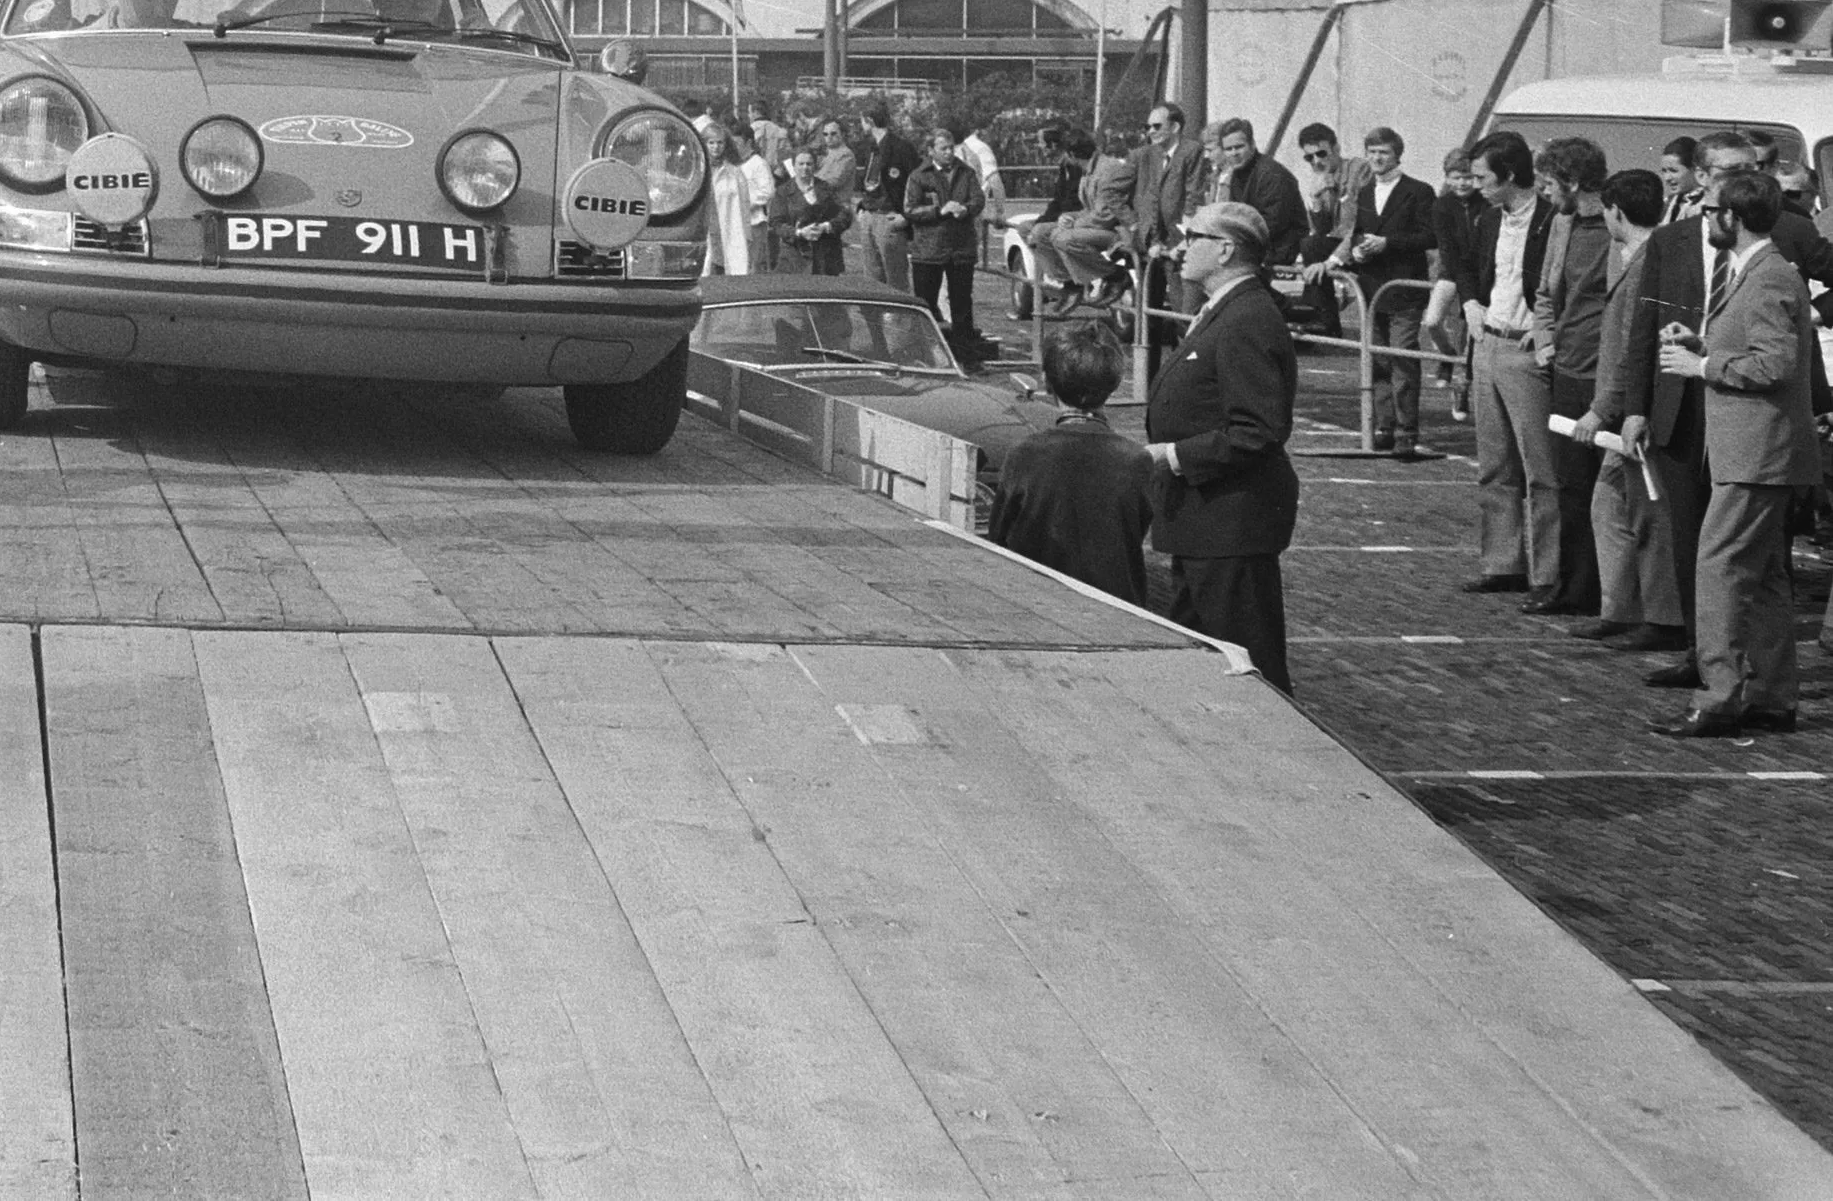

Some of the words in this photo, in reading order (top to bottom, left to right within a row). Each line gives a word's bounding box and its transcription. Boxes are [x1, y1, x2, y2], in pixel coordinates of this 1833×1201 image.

[227, 217, 328, 252] BPF
[355, 221, 419, 257] 911
[443, 227, 477, 262] H
